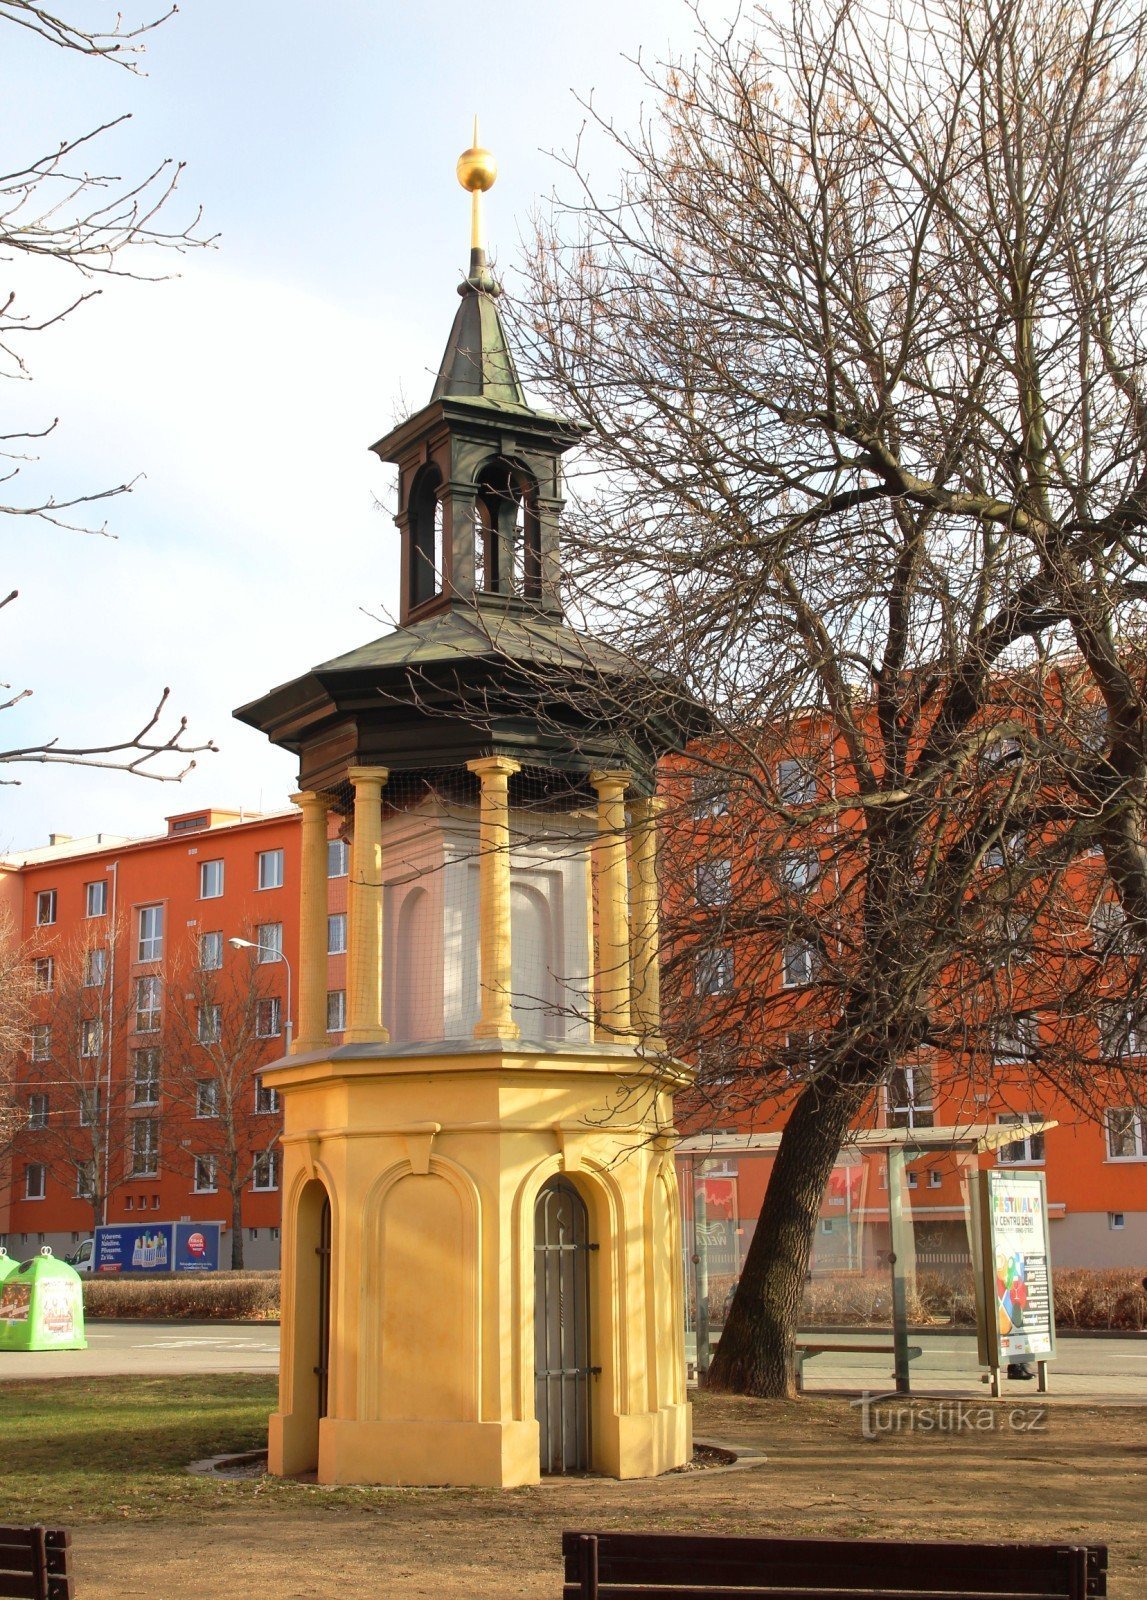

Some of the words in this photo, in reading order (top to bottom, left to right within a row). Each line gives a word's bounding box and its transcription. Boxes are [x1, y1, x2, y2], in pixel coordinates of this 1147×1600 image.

[994, 1196, 1032, 1213] FESTIVAL
[995, 1216, 999, 1226] V
[1000, 1216, 1021, 1226] CENTRU
